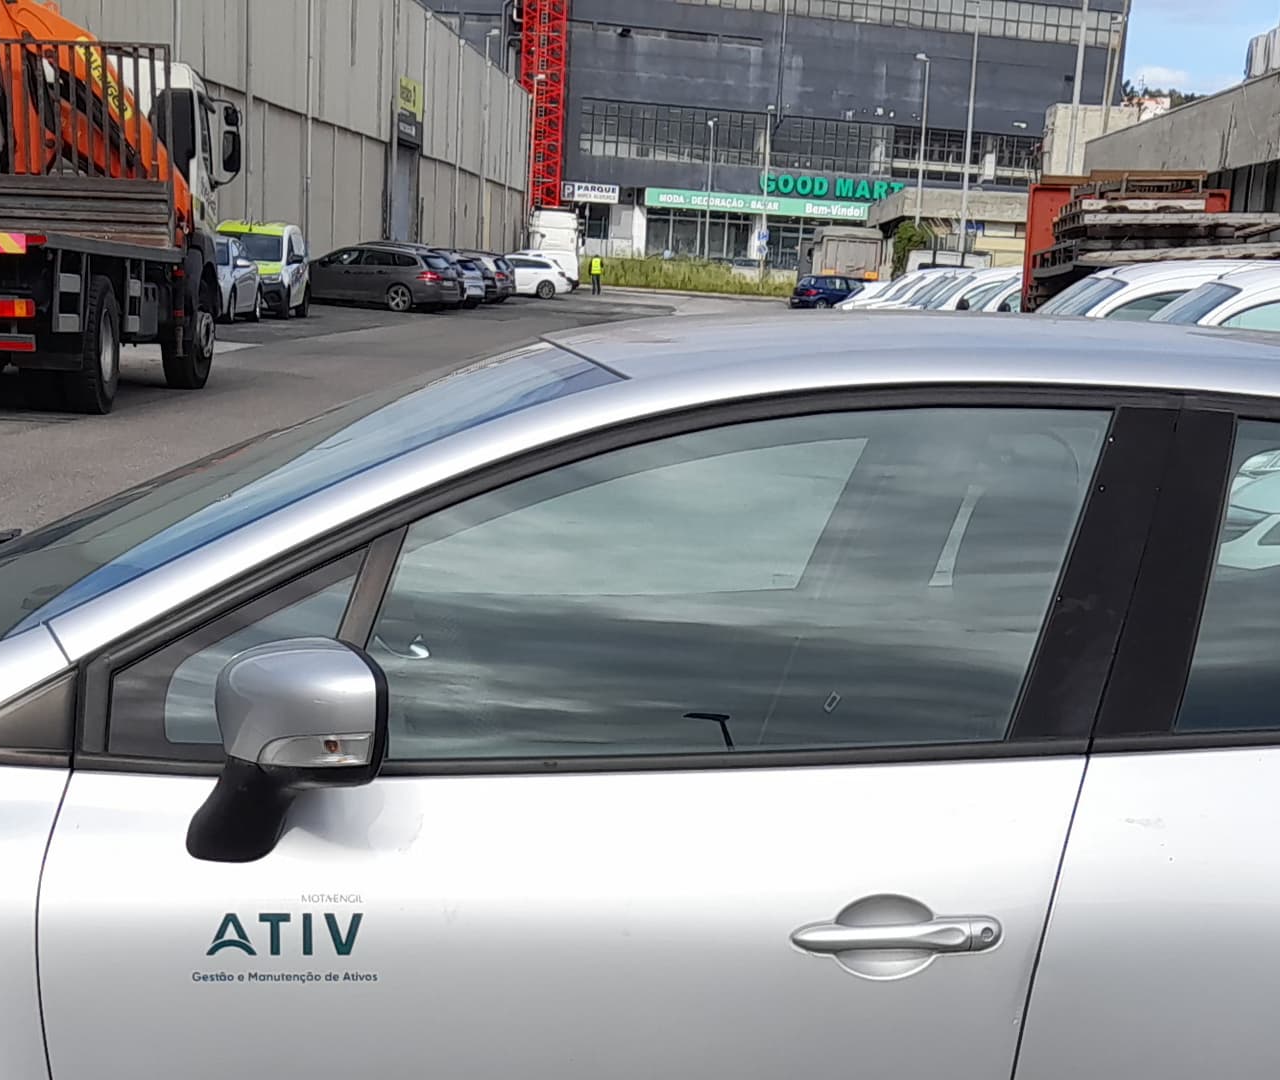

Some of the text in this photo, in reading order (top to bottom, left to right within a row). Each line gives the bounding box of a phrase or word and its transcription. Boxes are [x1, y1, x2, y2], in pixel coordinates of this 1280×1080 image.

[577, 184, 617, 193] PARQUE
[759, 171, 905, 200] GOOD MART
[659, 194, 684, 203] MODA
[691, 195, 744, 208] DECORAÇÃO
[805, 203, 865, 217] Bem-Vindo!
[206, 913, 363, 956] ATIV
[191, 971, 378, 984] Gestão e Manutenção de Ativos
